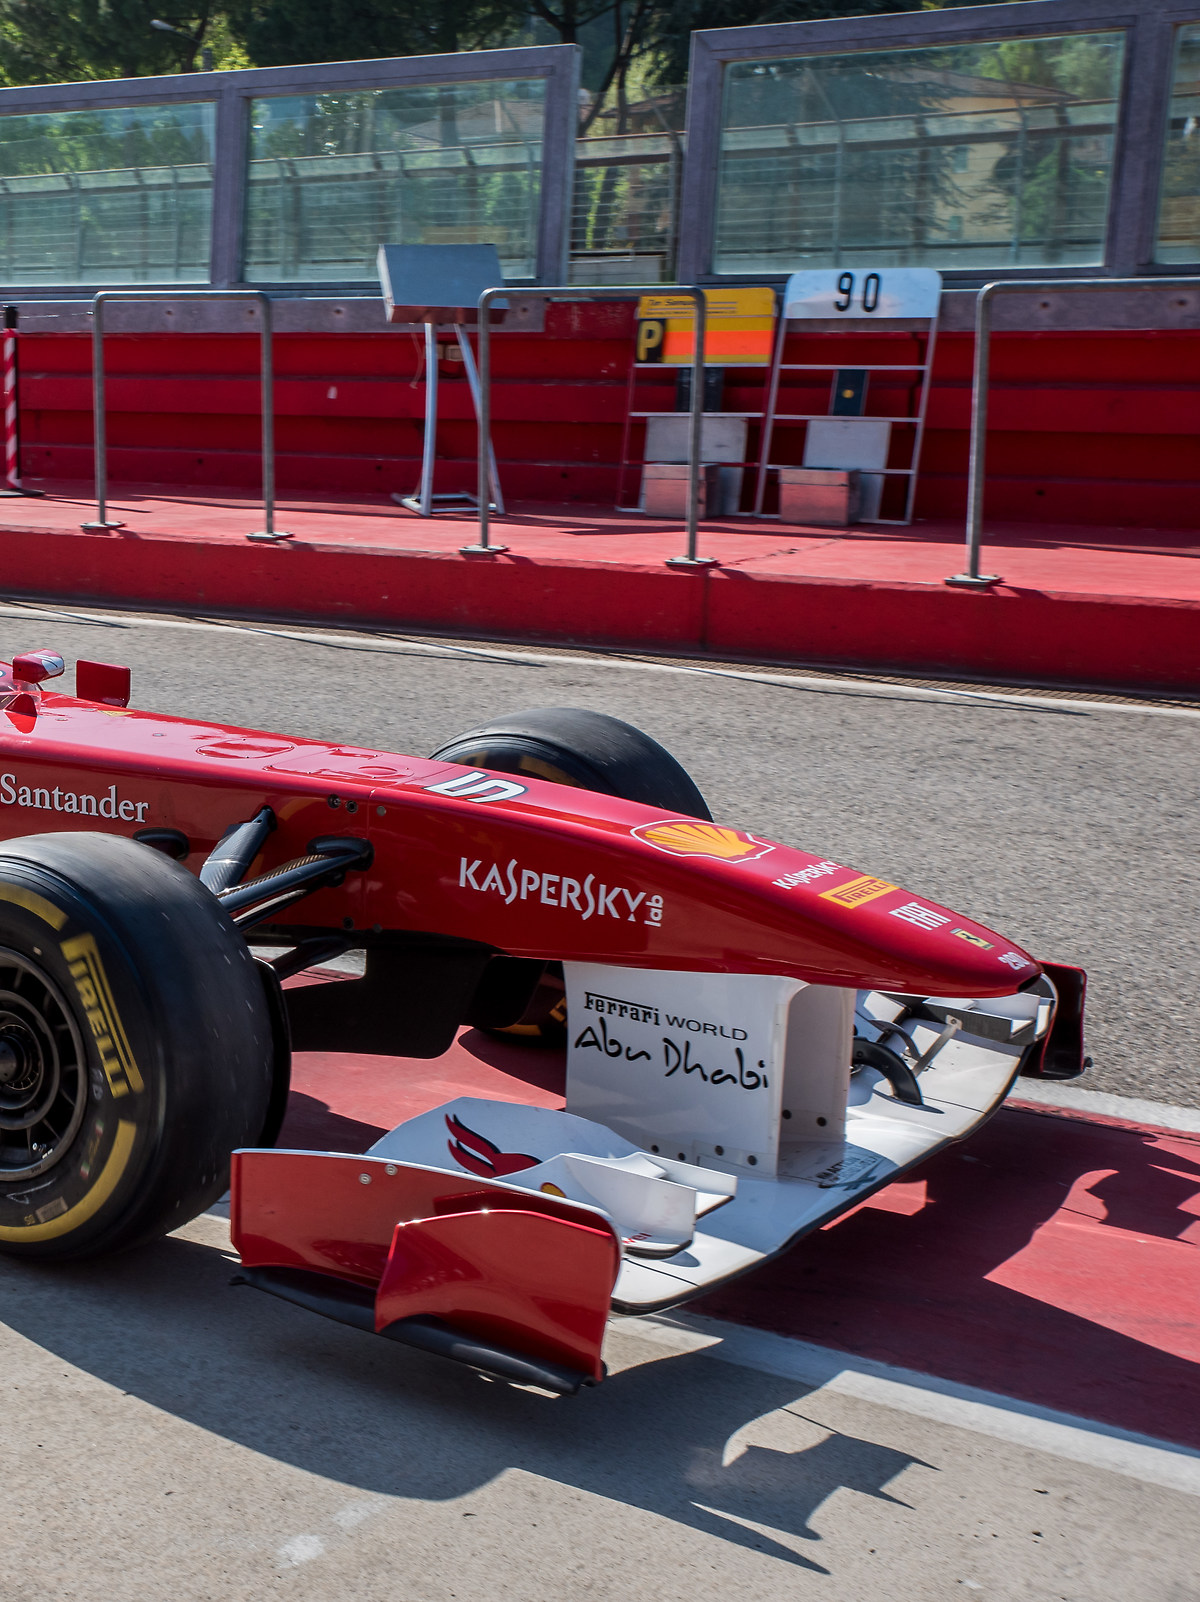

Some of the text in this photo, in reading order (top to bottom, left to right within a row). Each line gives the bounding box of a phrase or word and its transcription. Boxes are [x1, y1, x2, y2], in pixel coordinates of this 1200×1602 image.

[834, 271, 881, 314] 90
[637, 321, 663, 361] P
[0, 773, 149, 823] Santander
[423, 770, 530, 804] 5
[459, 857, 665, 928] KASPERSKY lab
[772, 860, 843, 890] KASPERSKY
[830, 879, 891, 904] PIRELLI
[888, 902, 952, 930] FIAT
[60, 932, 145, 1099] PIRELLI
[584, 991, 661, 1026] Ferrari
[665, 1014, 748, 1041] WORLD
[574, 1016, 769, 1090] Abu Dhabi
